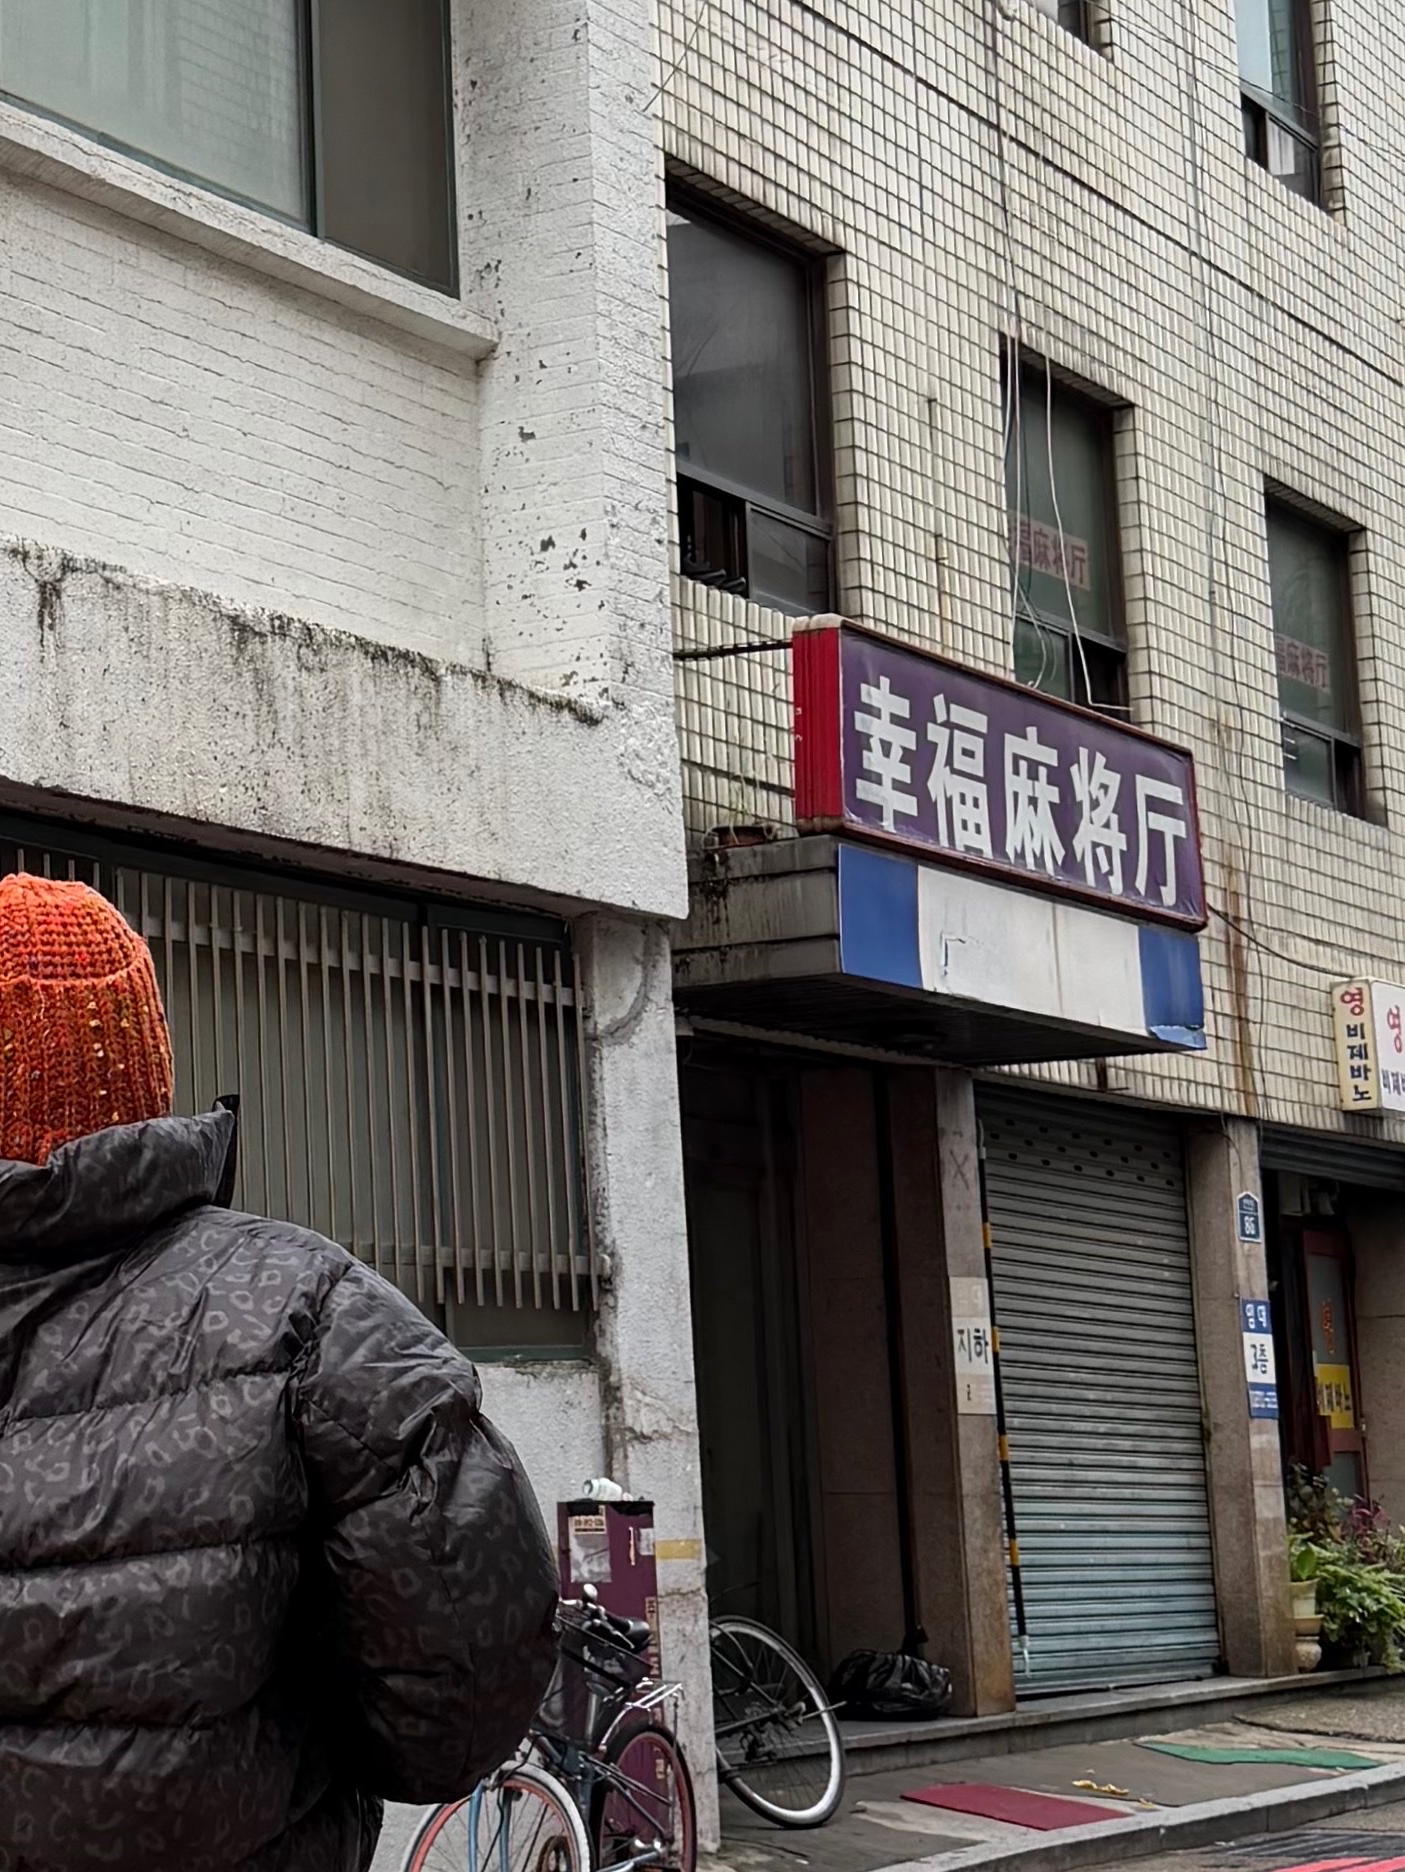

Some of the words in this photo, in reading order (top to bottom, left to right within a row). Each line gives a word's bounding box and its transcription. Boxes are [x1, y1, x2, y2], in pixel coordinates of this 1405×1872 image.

[854, 676, 1188, 907] 幸福麻将厅
[1346, 1022, 1372, 1101] 비제바노
[957, 1327, 989, 1364] 지하
